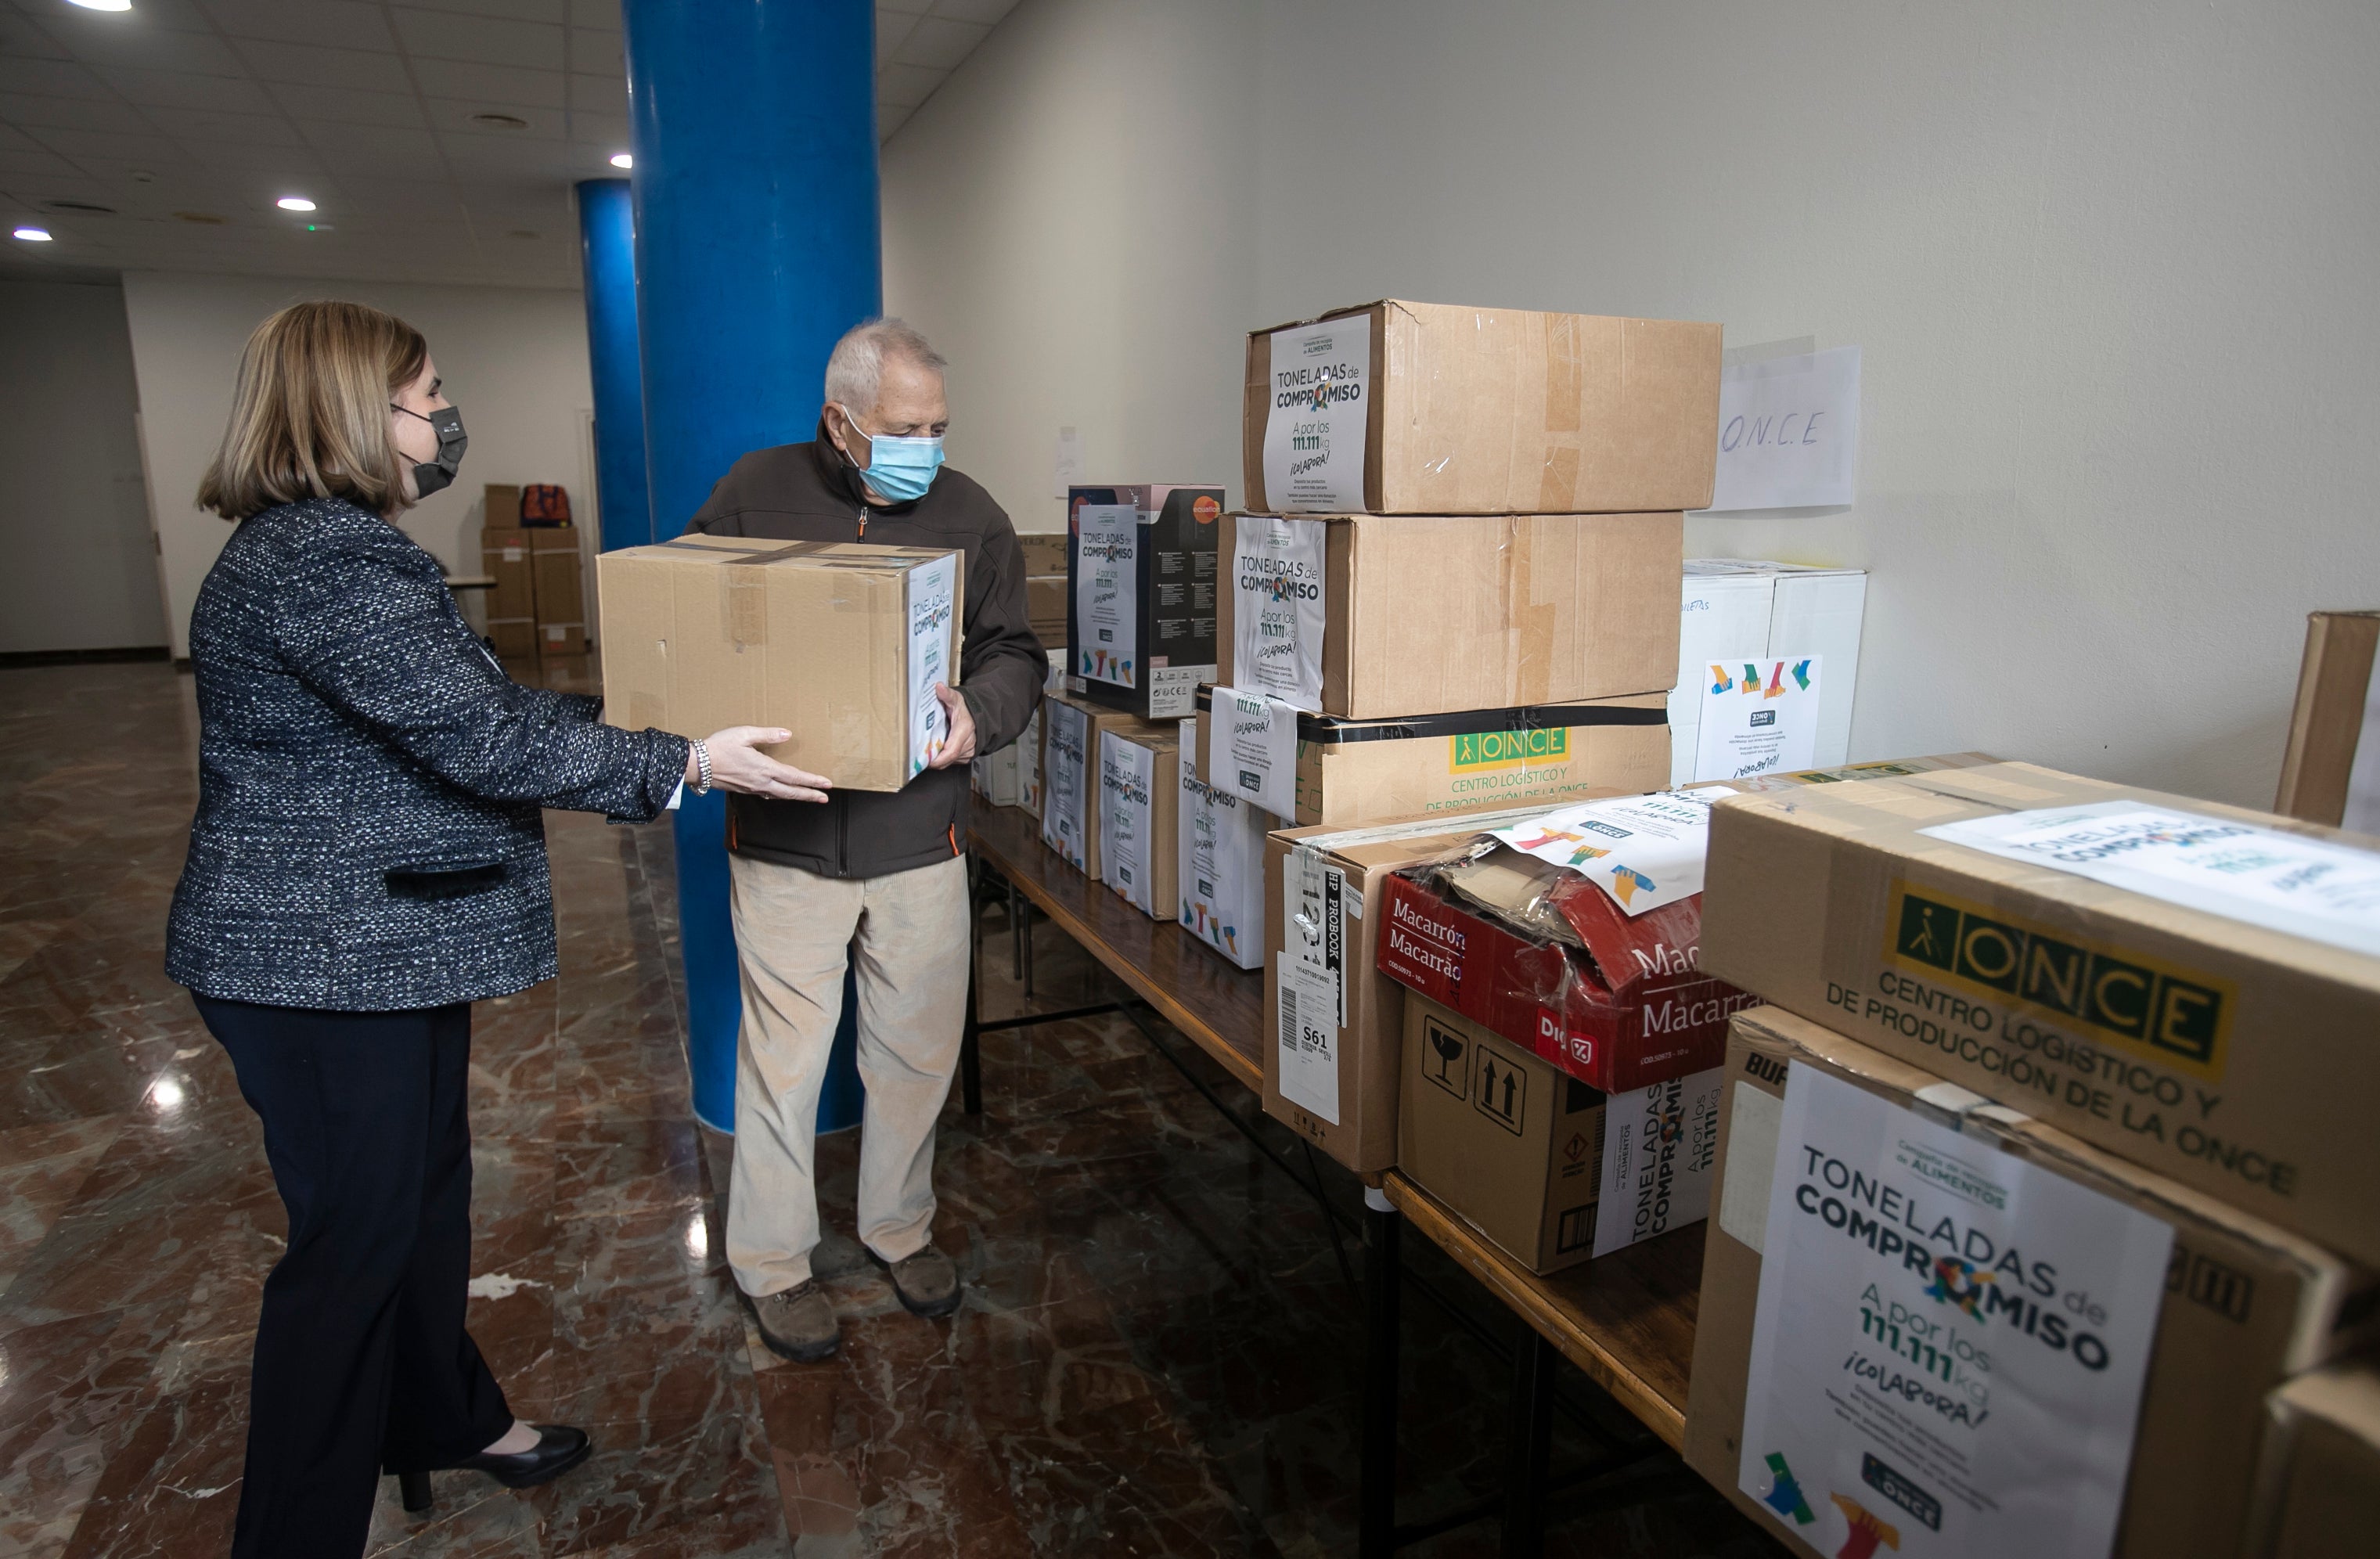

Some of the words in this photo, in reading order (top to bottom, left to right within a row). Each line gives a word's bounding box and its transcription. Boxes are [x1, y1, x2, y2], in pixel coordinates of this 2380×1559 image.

[1308, 344, 1332, 353] ALIMENTOS
[1277, 363, 1346, 388] TONELADAS
[1348, 365, 1359, 379] de
[1277, 383, 1360, 409] COMPROMISO
[1293, 421, 1299, 434] A
[1301, 423, 1316, 437] por
[1317, 420, 1329, 433] los
[1292, 435, 1320, 450] 111.111
[1320, 437, 1330, 451] kg
[1083, 545, 1132, 559] COMPROMISO
[1084, 533, 1124, 545] TONELADAS
[1241, 556, 1303, 578] TONELADAS
[1305, 567, 1317, 579] de
[1240, 575, 1318, 600] COMPROMISO
[1260, 608, 1266, 621] A
[1266, 612, 1281, 624] por
[1284, 610, 1295, 625] los
[1260, 622, 1284, 638] 111.111
[1285, 627, 1296, 642] kg
[1237, 698, 1262, 716] 111.111
[1258, 704, 1269, 720] kg
[1752, 712, 1768, 721] ONCE
[1233, 719, 1270, 735] ¡COLABORA!
[1482, 728, 1562, 756] ONCE
[1104, 760, 1141, 787] TONELADAS
[1245, 779, 1259, 790] ONCE
[1452, 776, 1498, 793] CENTRO
[1559, 767, 1568, 780] Y
[1104, 775, 1147, 805] COMPROMISO
[1642, 802, 1697, 818] 111.111
[1593, 825, 1624, 838] ONCE
[1329, 873, 1338, 891] HP
[1329, 898, 1339, 960] PROBOOK
[1393, 898, 1466, 950] Macarrón
[1390, 929, 1461, 981] Macarrão
[1963, 926, 2213, 1052] ONCE
[1303, 1025, 1327, 1050] S61
[1878, 971, 1995, 1033] CENTRO
[2193, 1091, 2224, 1121] Y
[1707, 1087, 1721, 1110] kg
[1826, 981, 1860, 1016] DE
[1865, 1000, 2059, 1095] PRODUCCIÓN
[2062, 1079, 2113, 1120] DE
[2122, 1103, 2166, 1143] LA
[2175, 1127, 2300, 1197] ONCE
[1691, 1094, 1705, 1122] los
[1621, 1124, 1630, 1179] ALIMENTOS
[1692, 1125, 1703, 1156] por
[1701, 1109, 1718, 1171] 111.111
[1632, 1083, 1662, 1243] TONELADAS
[1688, 1159, 1701, 1173] A
[1912, 1160, 2005, 1210] ALIMENTOS
[1802, 1144, 2058, 1297] TONELADAS
[2063, 1290, 2108, 1327] de
[1795, 1183, 2111, 1373] COMPROMISO
[1860, 1283, 1884, 1306] A
[1889, 1298, 1943, 1339] por
[1946, 1324, 1993, 1371] los
[1859, 1307, 1955, 1384] 111.111
[1954, 1364, 1990, 1408] kg
[1883, 1479, 1935, 1528] ONCE
